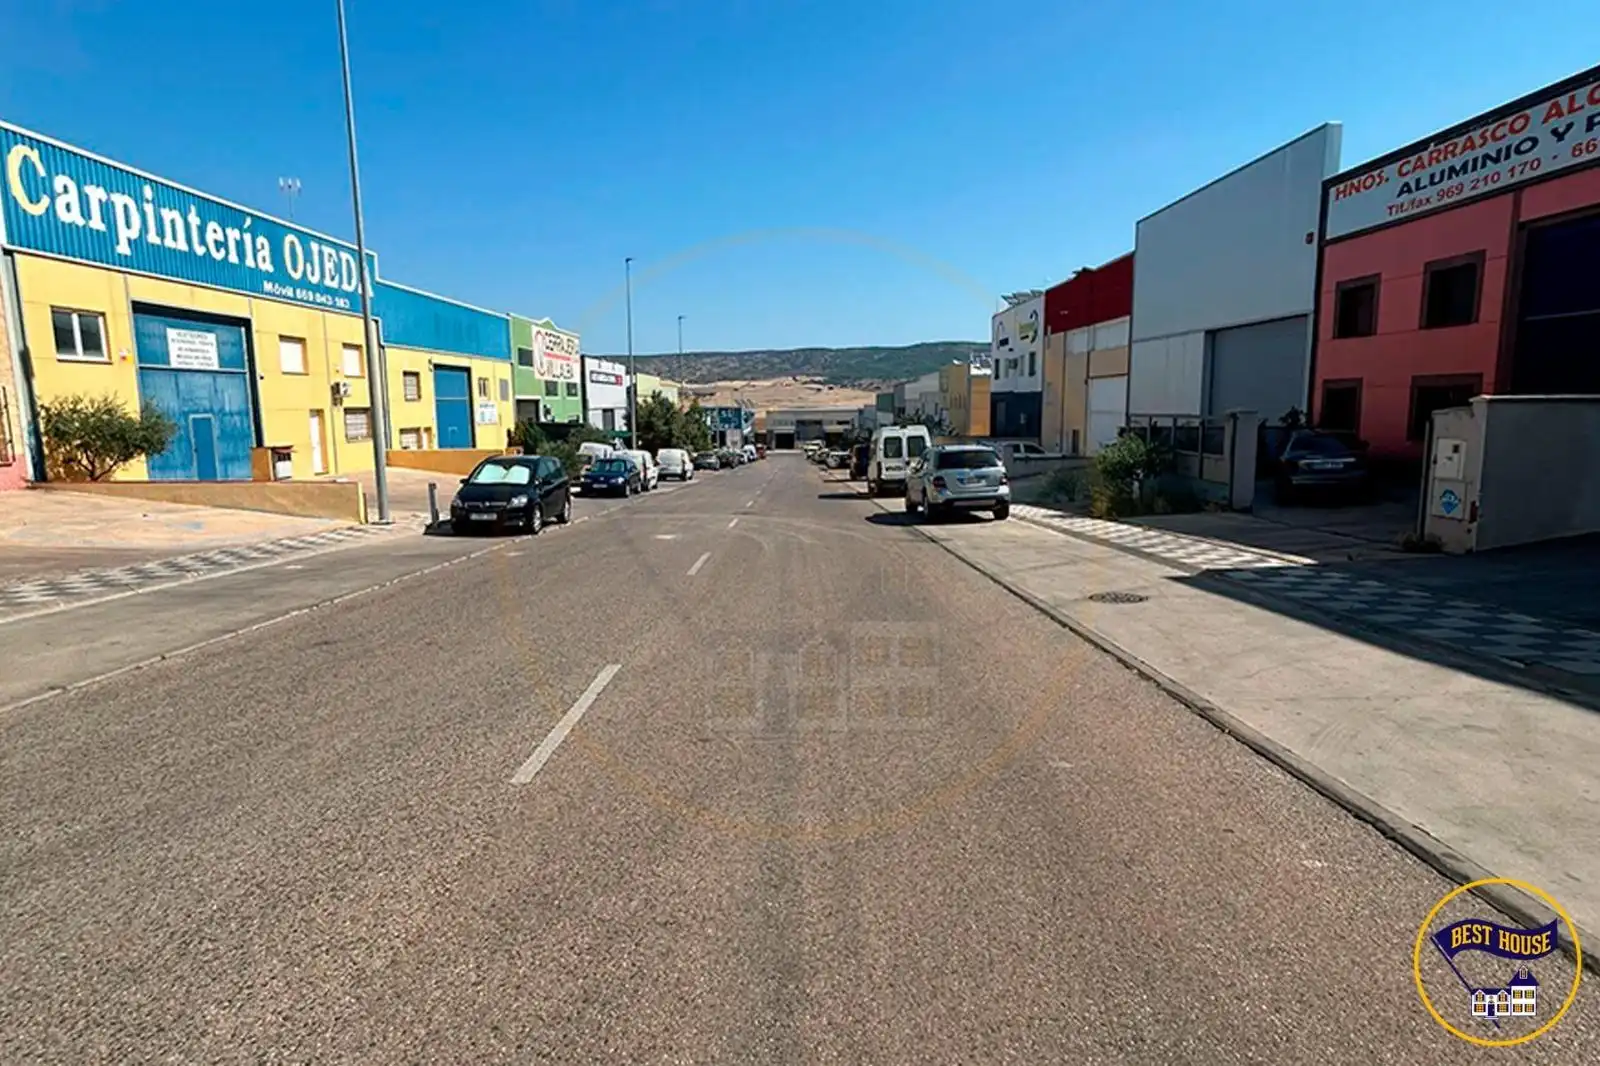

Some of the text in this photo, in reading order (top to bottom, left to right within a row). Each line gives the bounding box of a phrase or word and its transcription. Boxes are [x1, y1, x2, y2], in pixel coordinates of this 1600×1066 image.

[1335, 170, 1390, 202] HNOS.
[1397, 112, 1531, 178] CARRASCO
[1396, 136, 1539, 199] ALUMINIO
[1550, 121, 1575, 144] Y
[1437, 182, 1464, 203] 969
[1470, 170, 1501, 193] 210
[1507, 157, 1542, 179] 170
[6, 144, 374, 297] Carpintería OJEDA
